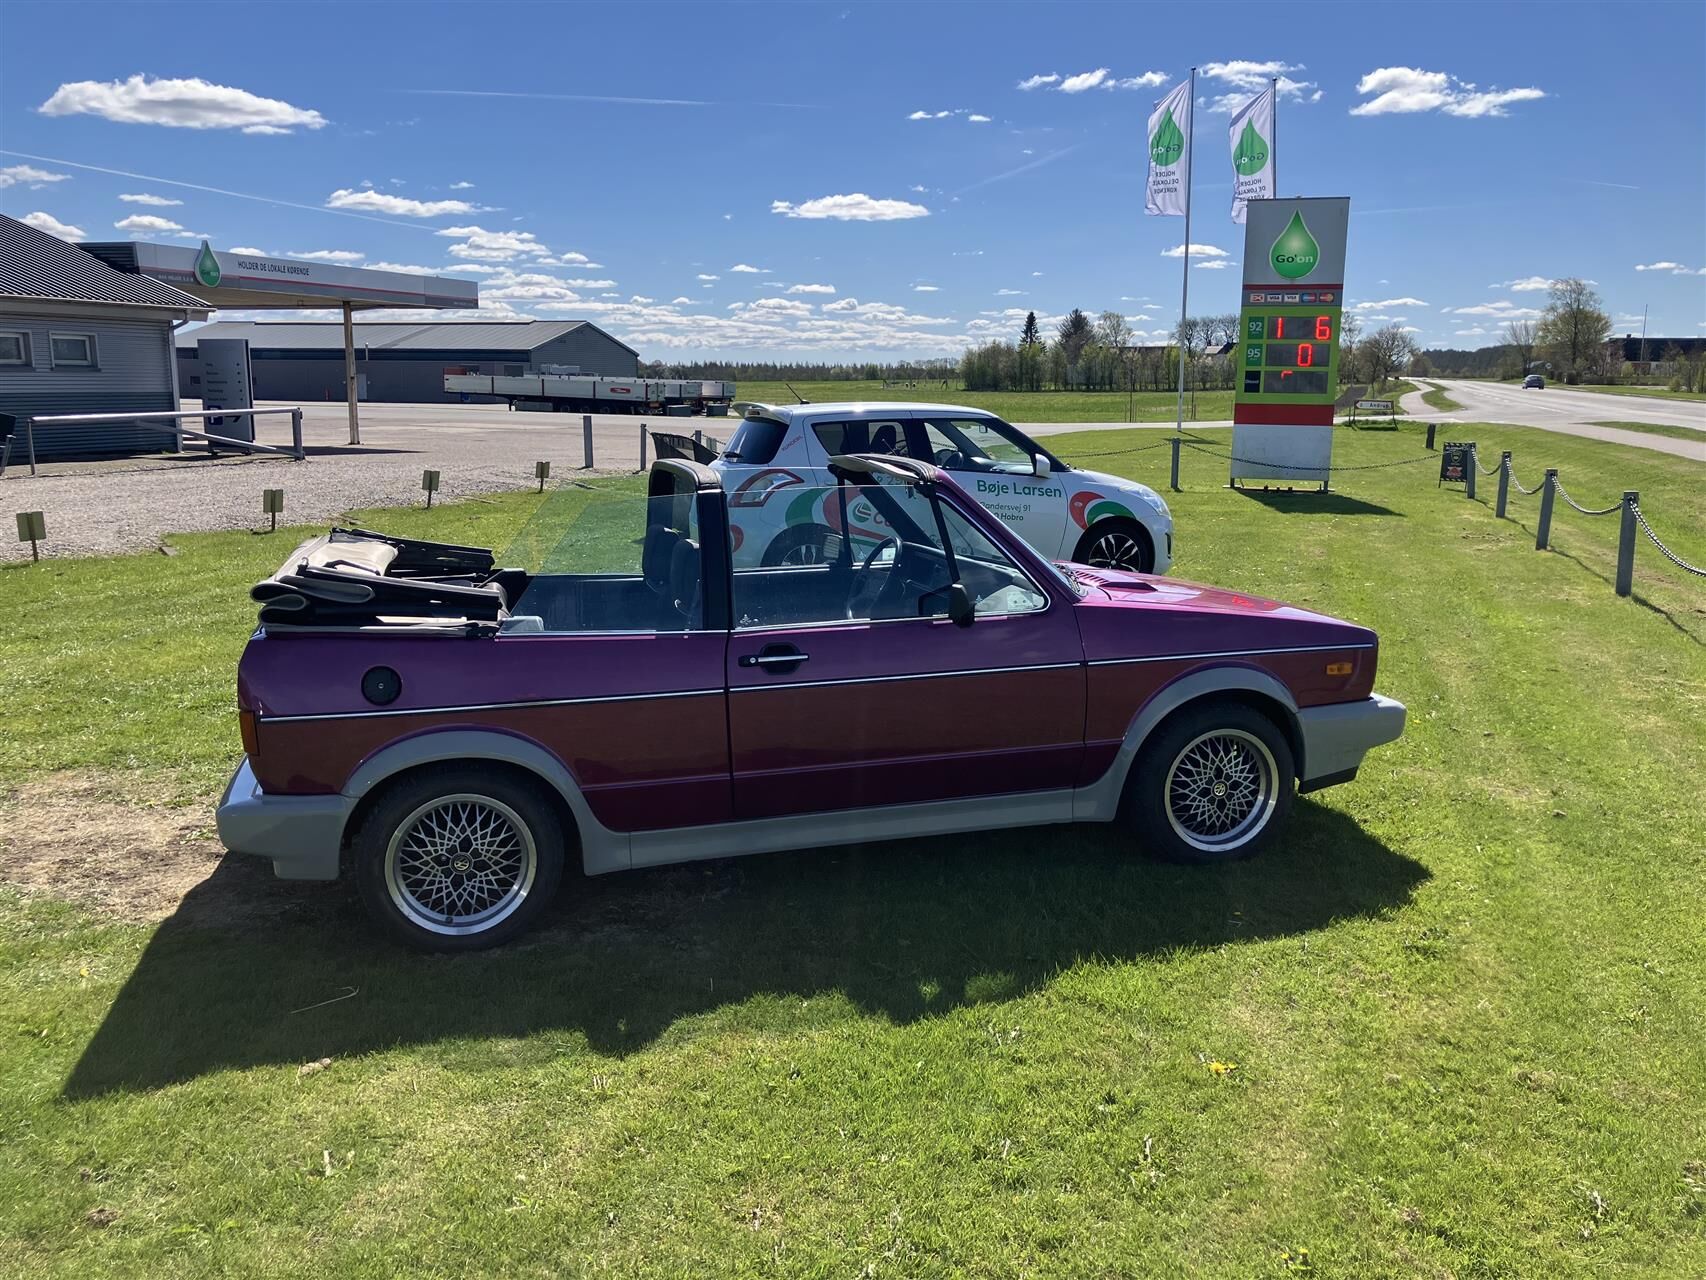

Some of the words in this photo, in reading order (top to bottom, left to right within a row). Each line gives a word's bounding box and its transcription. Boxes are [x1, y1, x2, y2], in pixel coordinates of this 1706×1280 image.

[1276, 254, 1313, 263] Go'on
[238, 261, 258, 271] HOLDER
[259, 263, 267, 271] DE
[267, 264, 286, 273] LOKALE
[286, 266, 310, 276] KØRENDE
[1249, 321, 1262, 331] 92
[1315, 316, 1330, 340] 6
[1247, 348, 1260, 358] 95
[1297, 343, 1312, 367] 0
[976, 479, 1009, 497] Bøje
[1013, 482, 1062, 497] Larsen
[1023, 504, 1031, 512] 91
[1000, 512, 1024, 521] Hobro
